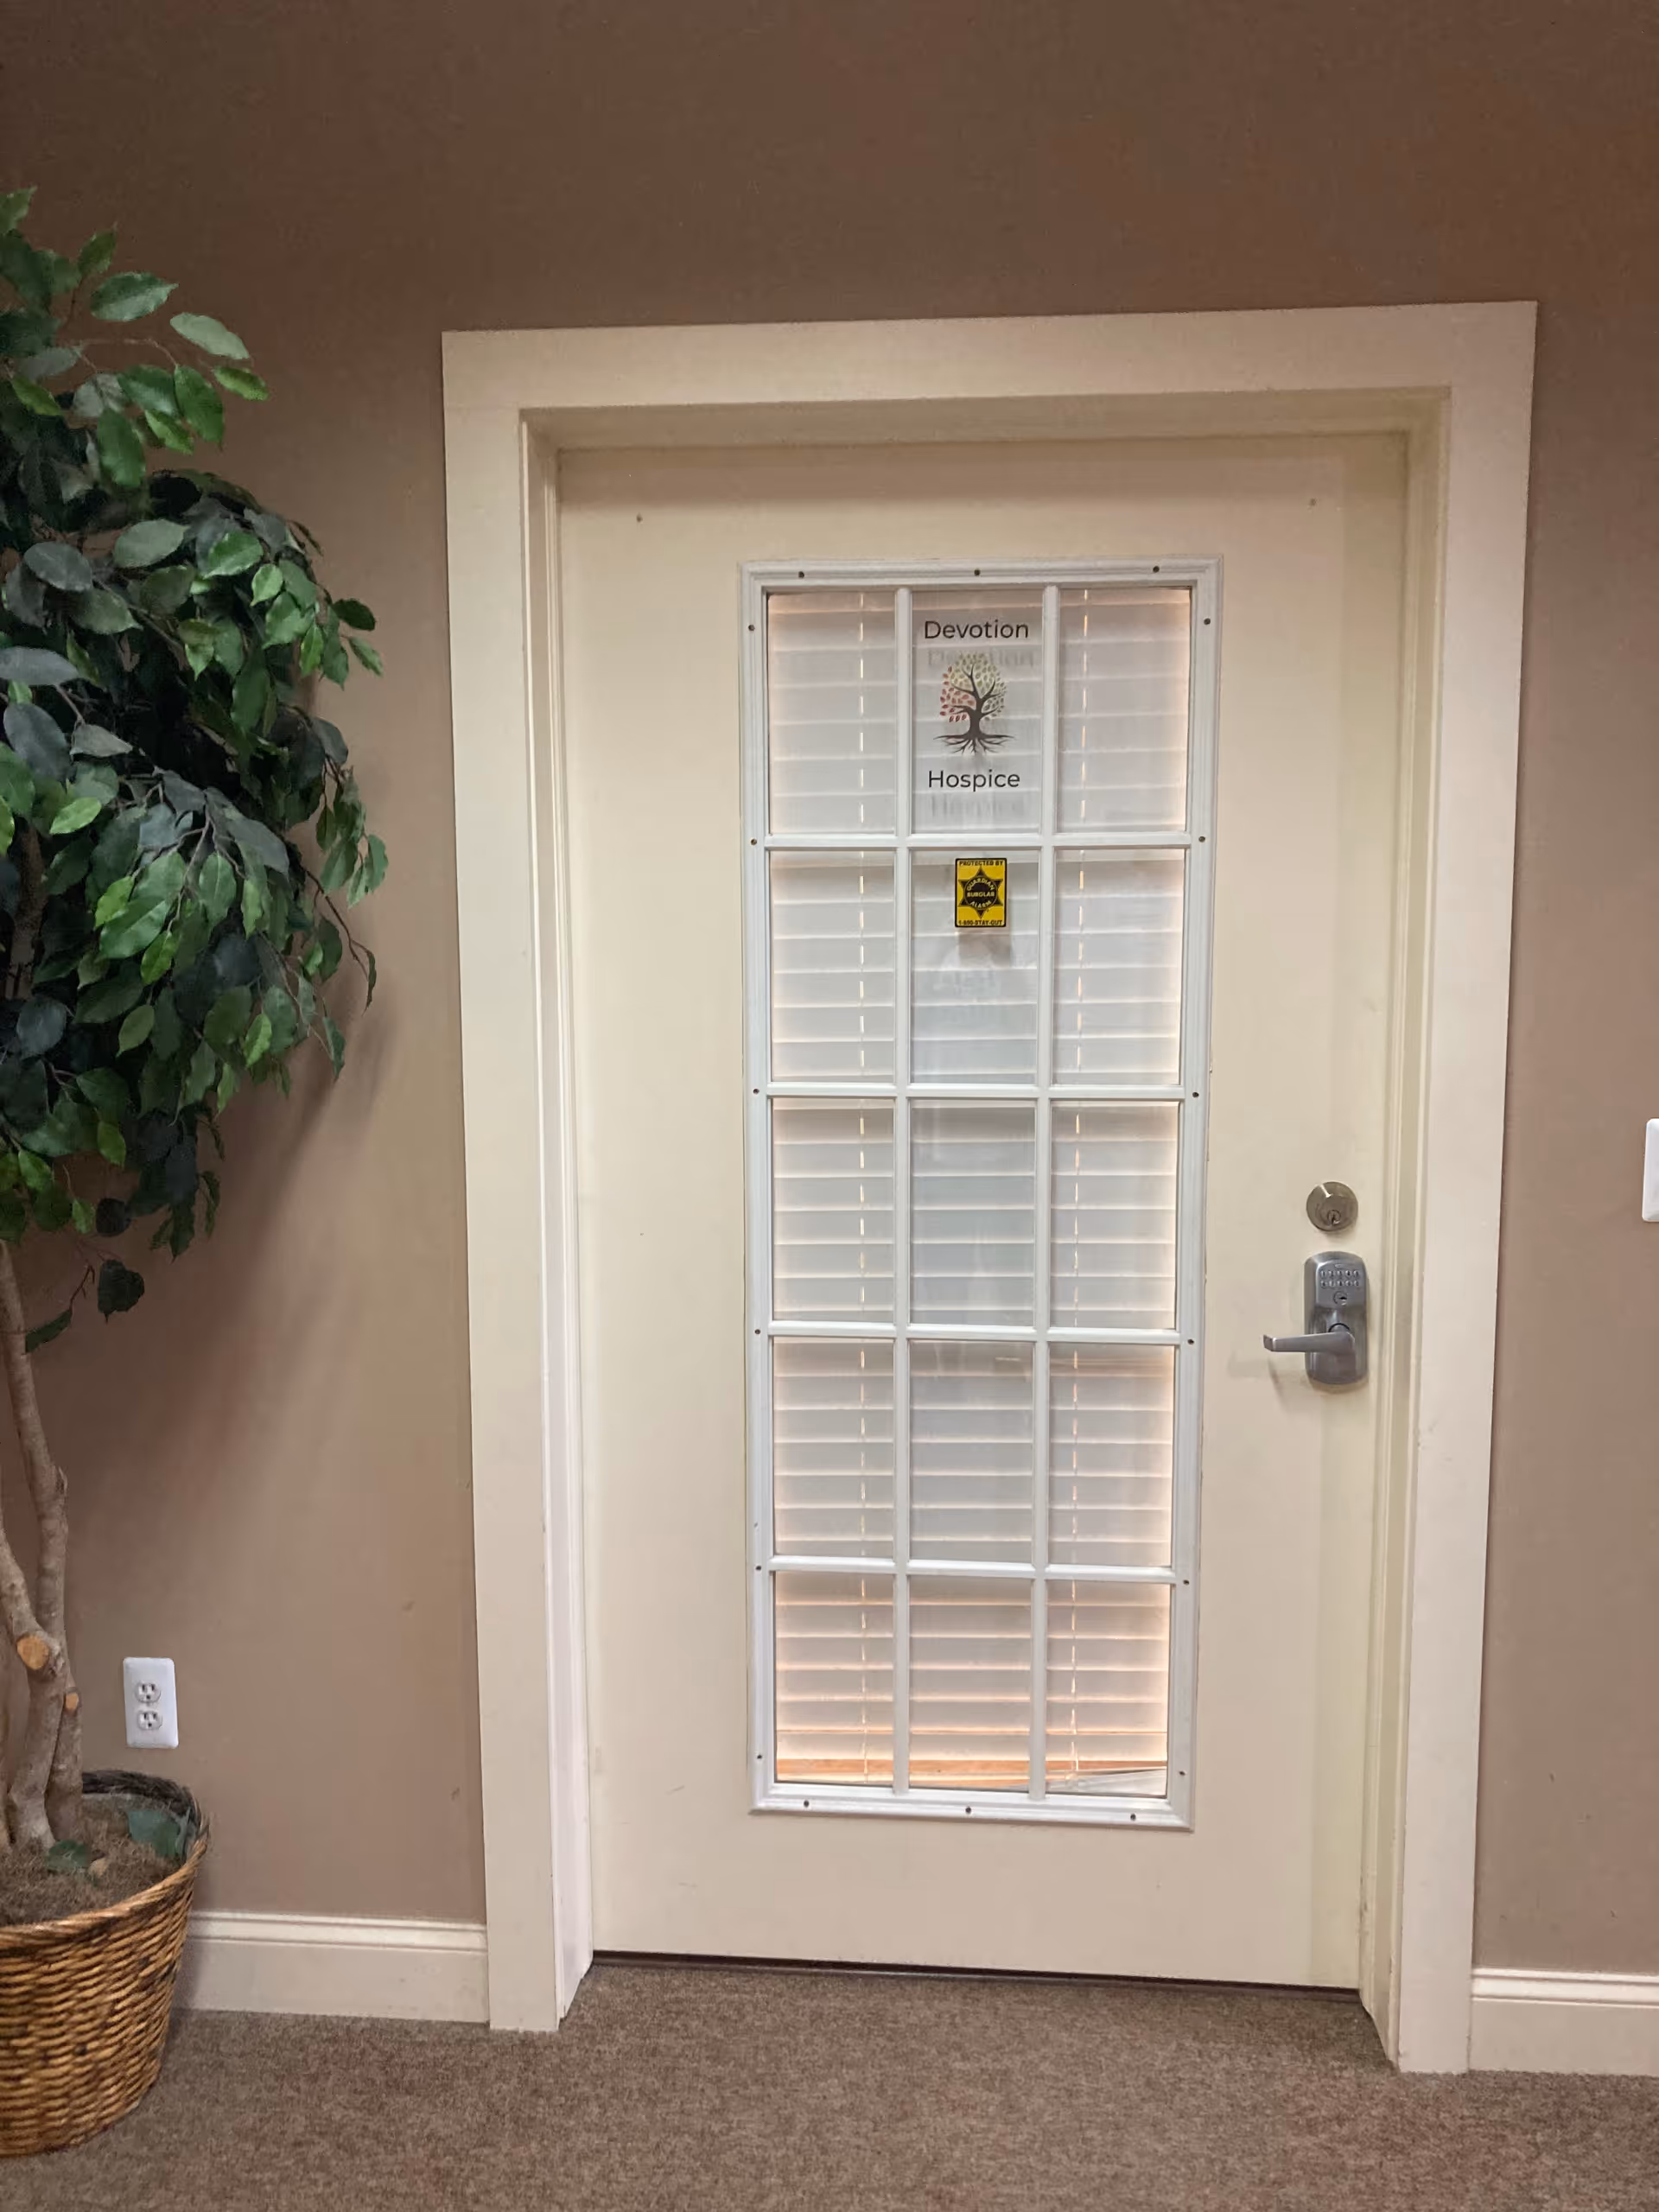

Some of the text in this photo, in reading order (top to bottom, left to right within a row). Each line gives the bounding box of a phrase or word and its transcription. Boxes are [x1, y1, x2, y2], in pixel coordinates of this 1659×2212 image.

[925, 619, 1029, 639] Devotion
[928, 769, 1020, 792] Hospice
[967, 878, 995, 891] GUARDIAN
